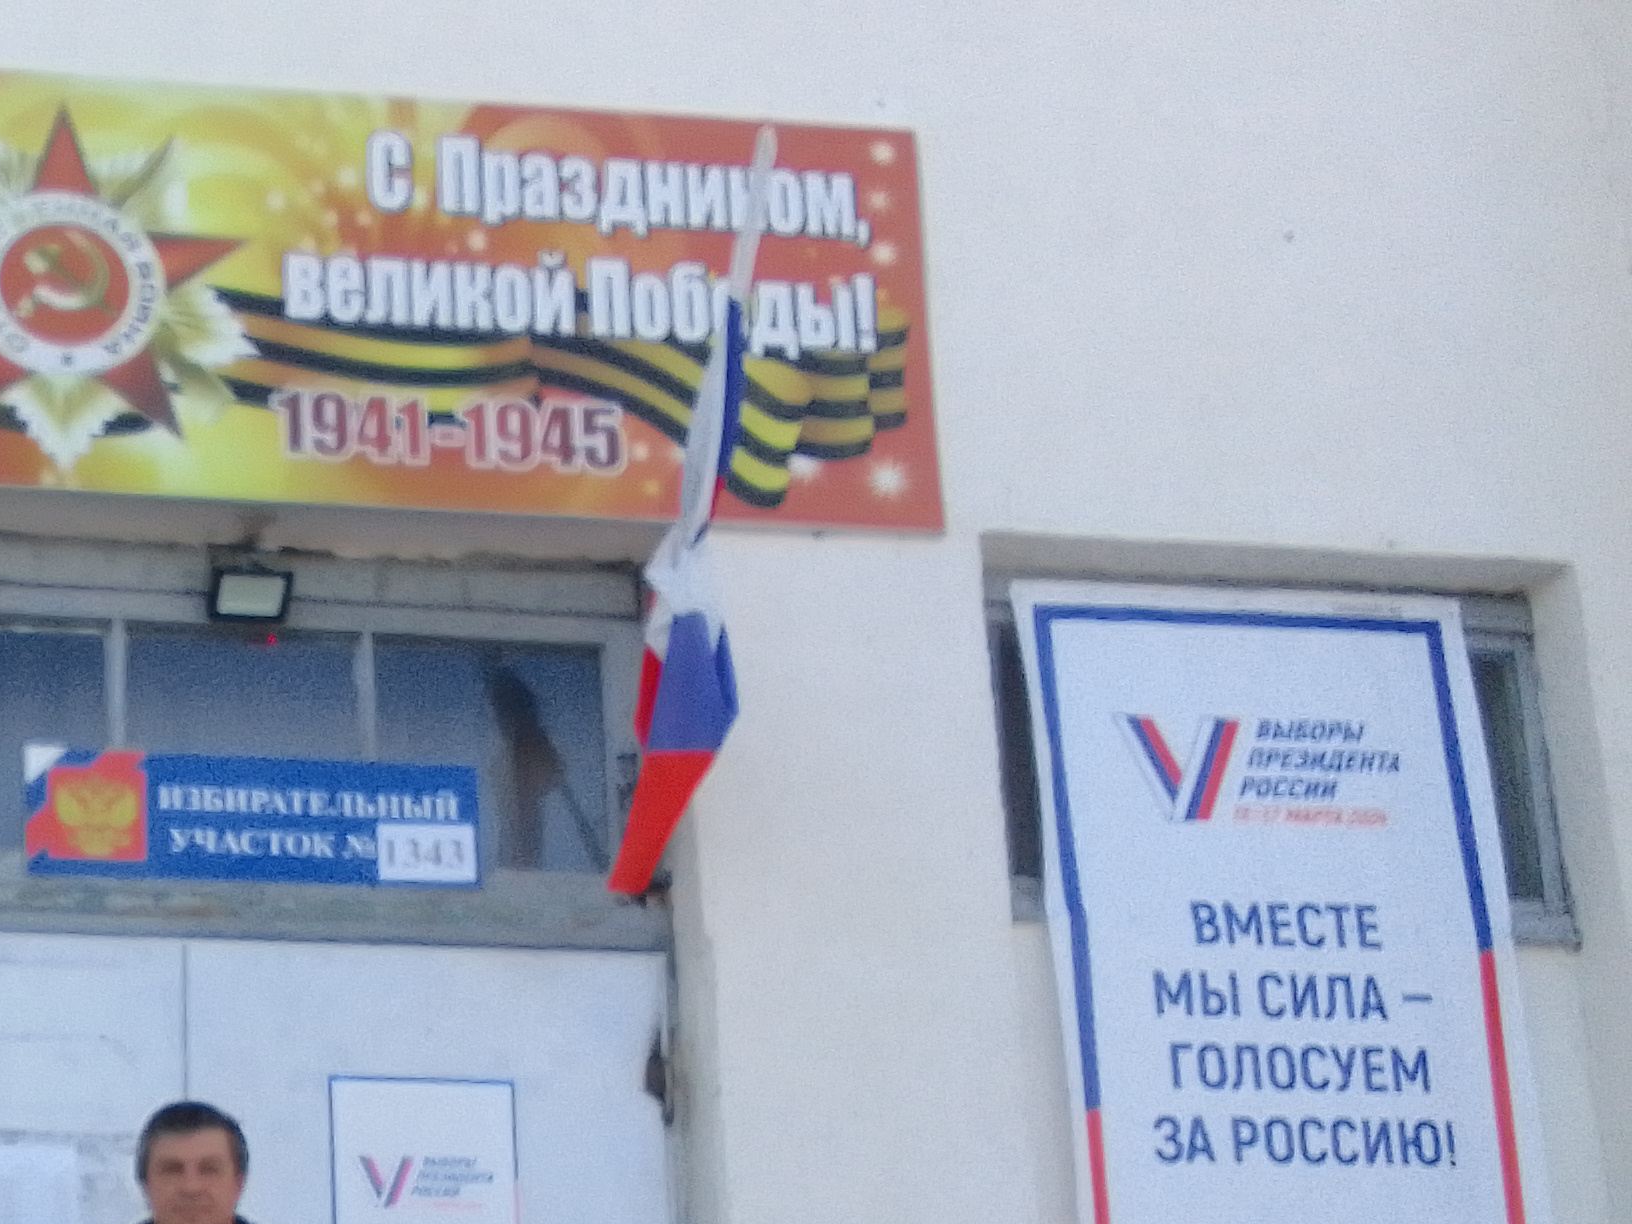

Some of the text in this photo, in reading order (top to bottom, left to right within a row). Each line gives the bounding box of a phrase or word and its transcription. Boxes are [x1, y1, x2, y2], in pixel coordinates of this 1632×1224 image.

[365, 129, 414, 213] С
[273, 388, 630, 477] 1941-1945
[1255, 717, 1366, 744] ВЫБОРЫ
[1245, 748, 1402, 774] ПРЕЗИДЕНТА
[157, 784, 460, 821] ИЗБИРАТЕЛЬНЫЙ
[1238, 775, 1339, 802] РОССИИ
[168, 827, 336, 859] УЧАСТОК
[1190, 900, 1383, 951] ВМЕСТЕ
[1152, 969, 1241, 1018] МЫ
[1257, 970, 1389, 1023] СИЛА
[1169, 1041, 1431, 1094] ГОЛОСУЕМ
[1154, 1114, 1457, 1168] ЗА РОССИЮ!
